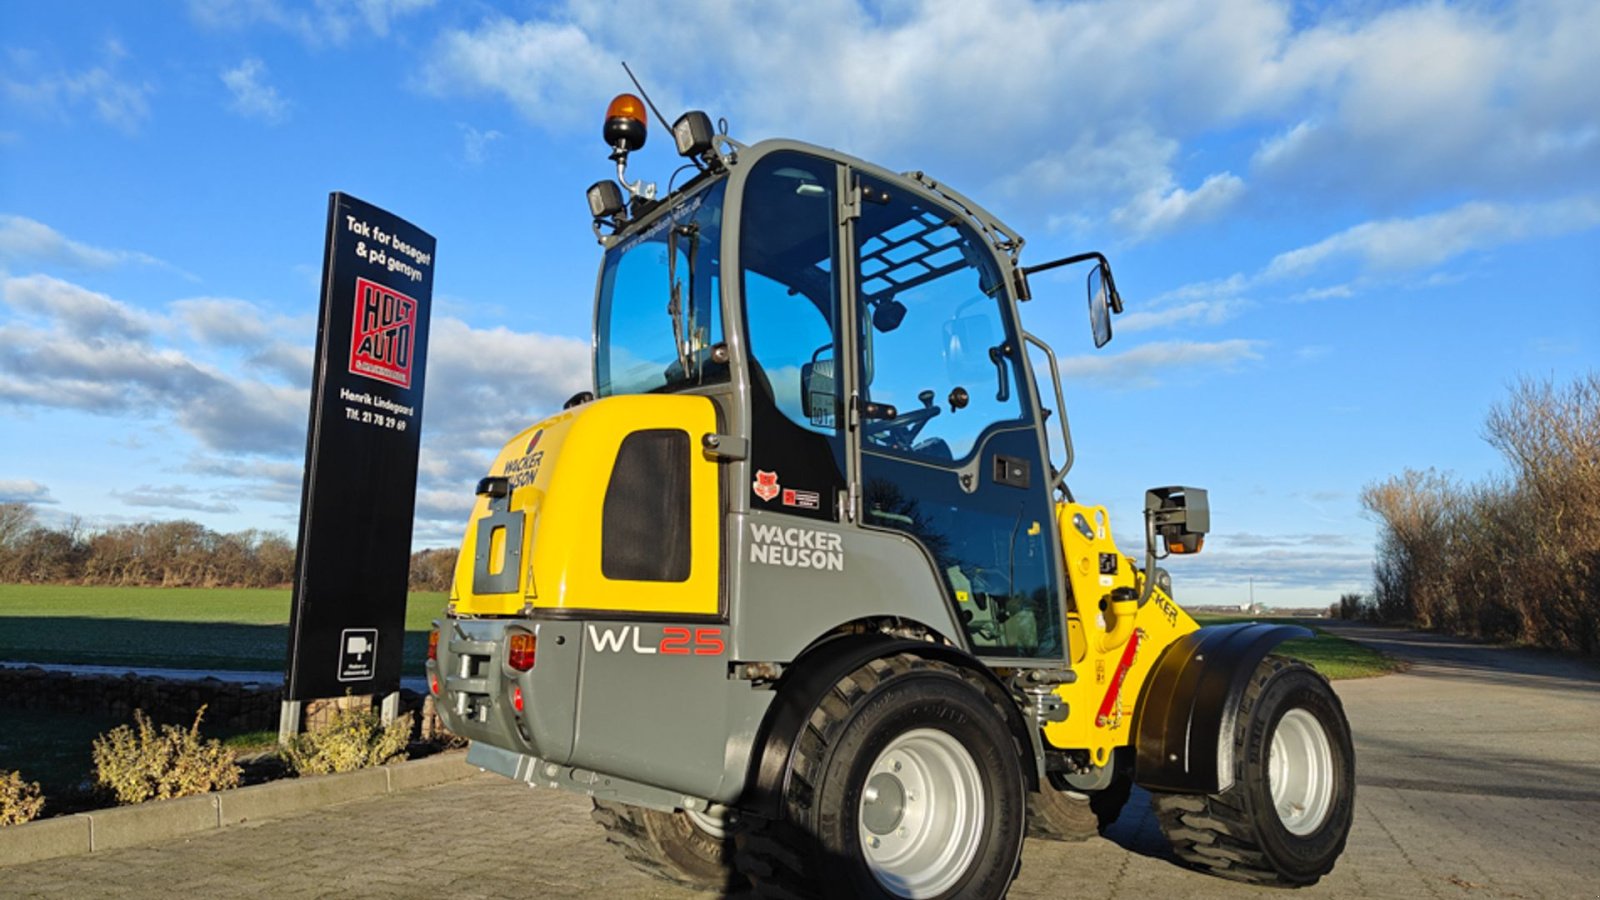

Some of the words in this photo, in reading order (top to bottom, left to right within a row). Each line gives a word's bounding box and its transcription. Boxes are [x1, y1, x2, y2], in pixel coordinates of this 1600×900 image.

[346, 215, 370, 237] Tak
[372, 226, 391, 245] for
[392, 234, 431, 266] besøget
[355, 241, 367, 258] &
[369, 249, 386, 265] på
[387, 257, 423, 281] gensyn
[362, 285, 412, 334] HOLT
[357, 324, 411, 368] AUTO
[340, 387, 372, 405] Henrik
[373, 395, 414, 417] Lindegaard
[362, 411, 372, 423] 21
[504, 450, 544, 474] WACKER
[750, 523, 844, 551] WACKER
[750, 544, 844, 571] NEUSON
[587, 625, 725, 655] WL25
